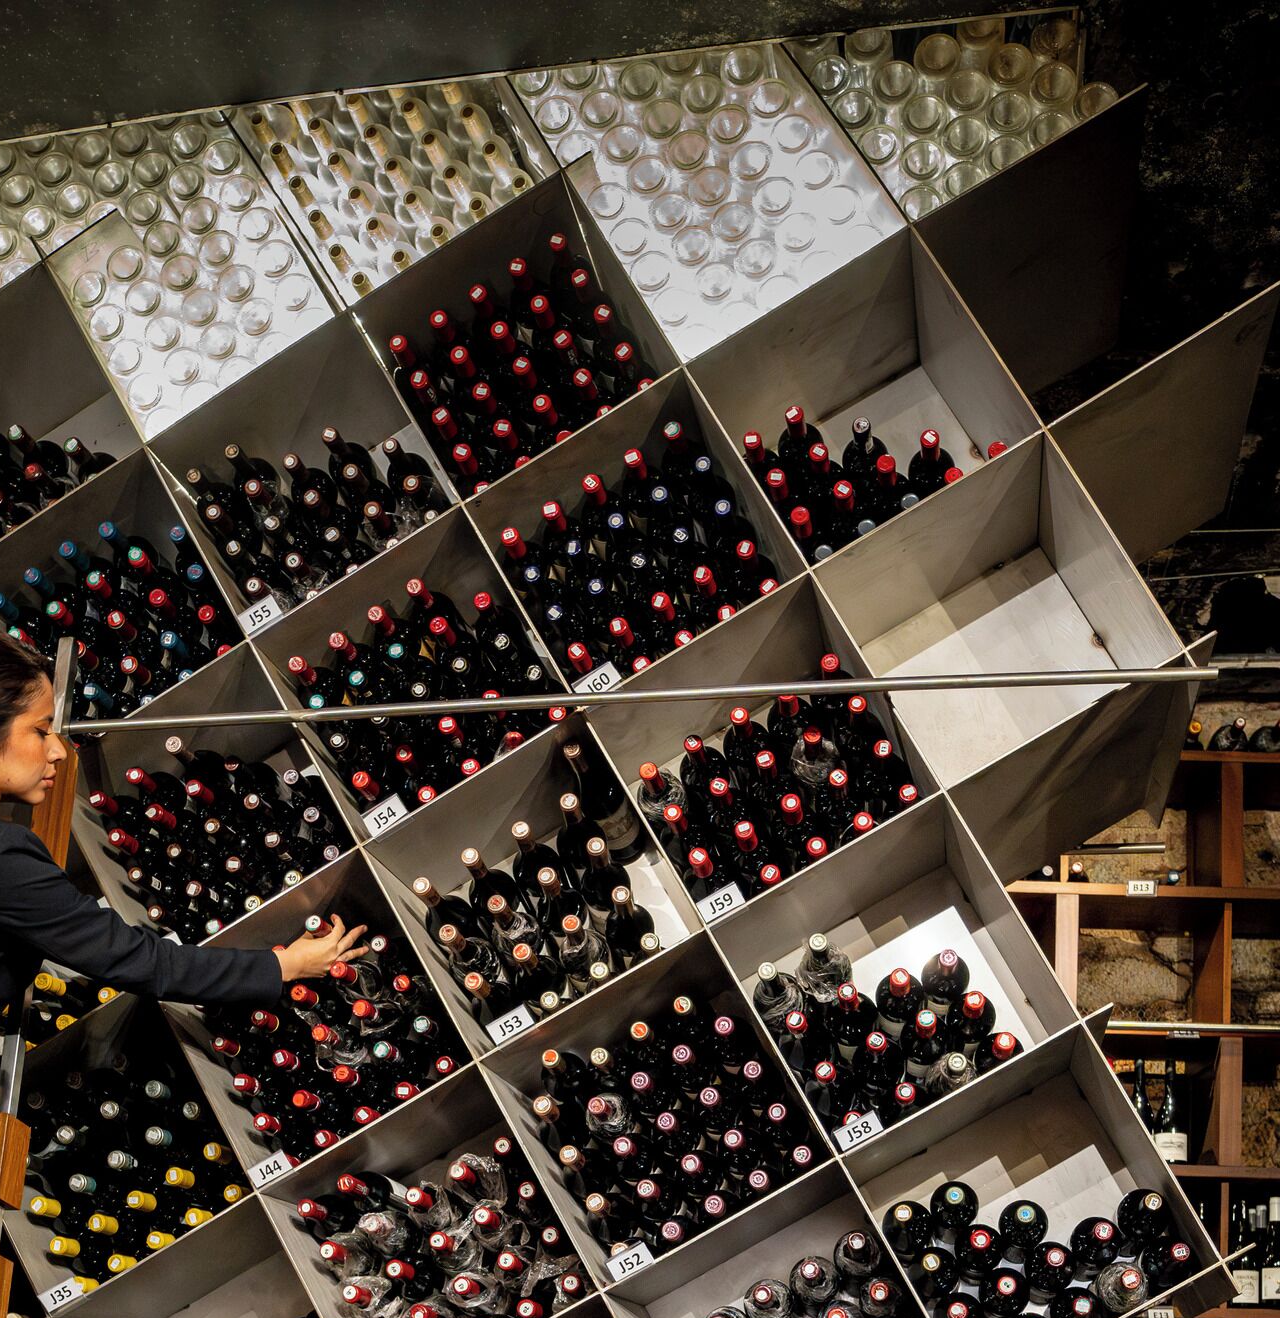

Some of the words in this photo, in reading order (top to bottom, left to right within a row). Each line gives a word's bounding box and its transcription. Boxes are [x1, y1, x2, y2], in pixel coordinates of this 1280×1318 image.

[248, 605, 272, 626] J55
[373, 806, 396, 829] J54
[709, 893, 733, 914] J59
[499, 1015, 522, 1037] J53
[847, 1121, 872, 1142] J58
[259, 1160, 282, 1180] J44
[619, 1253, 644, 1273] J52
[50, 1286, 72, 1304] J35
